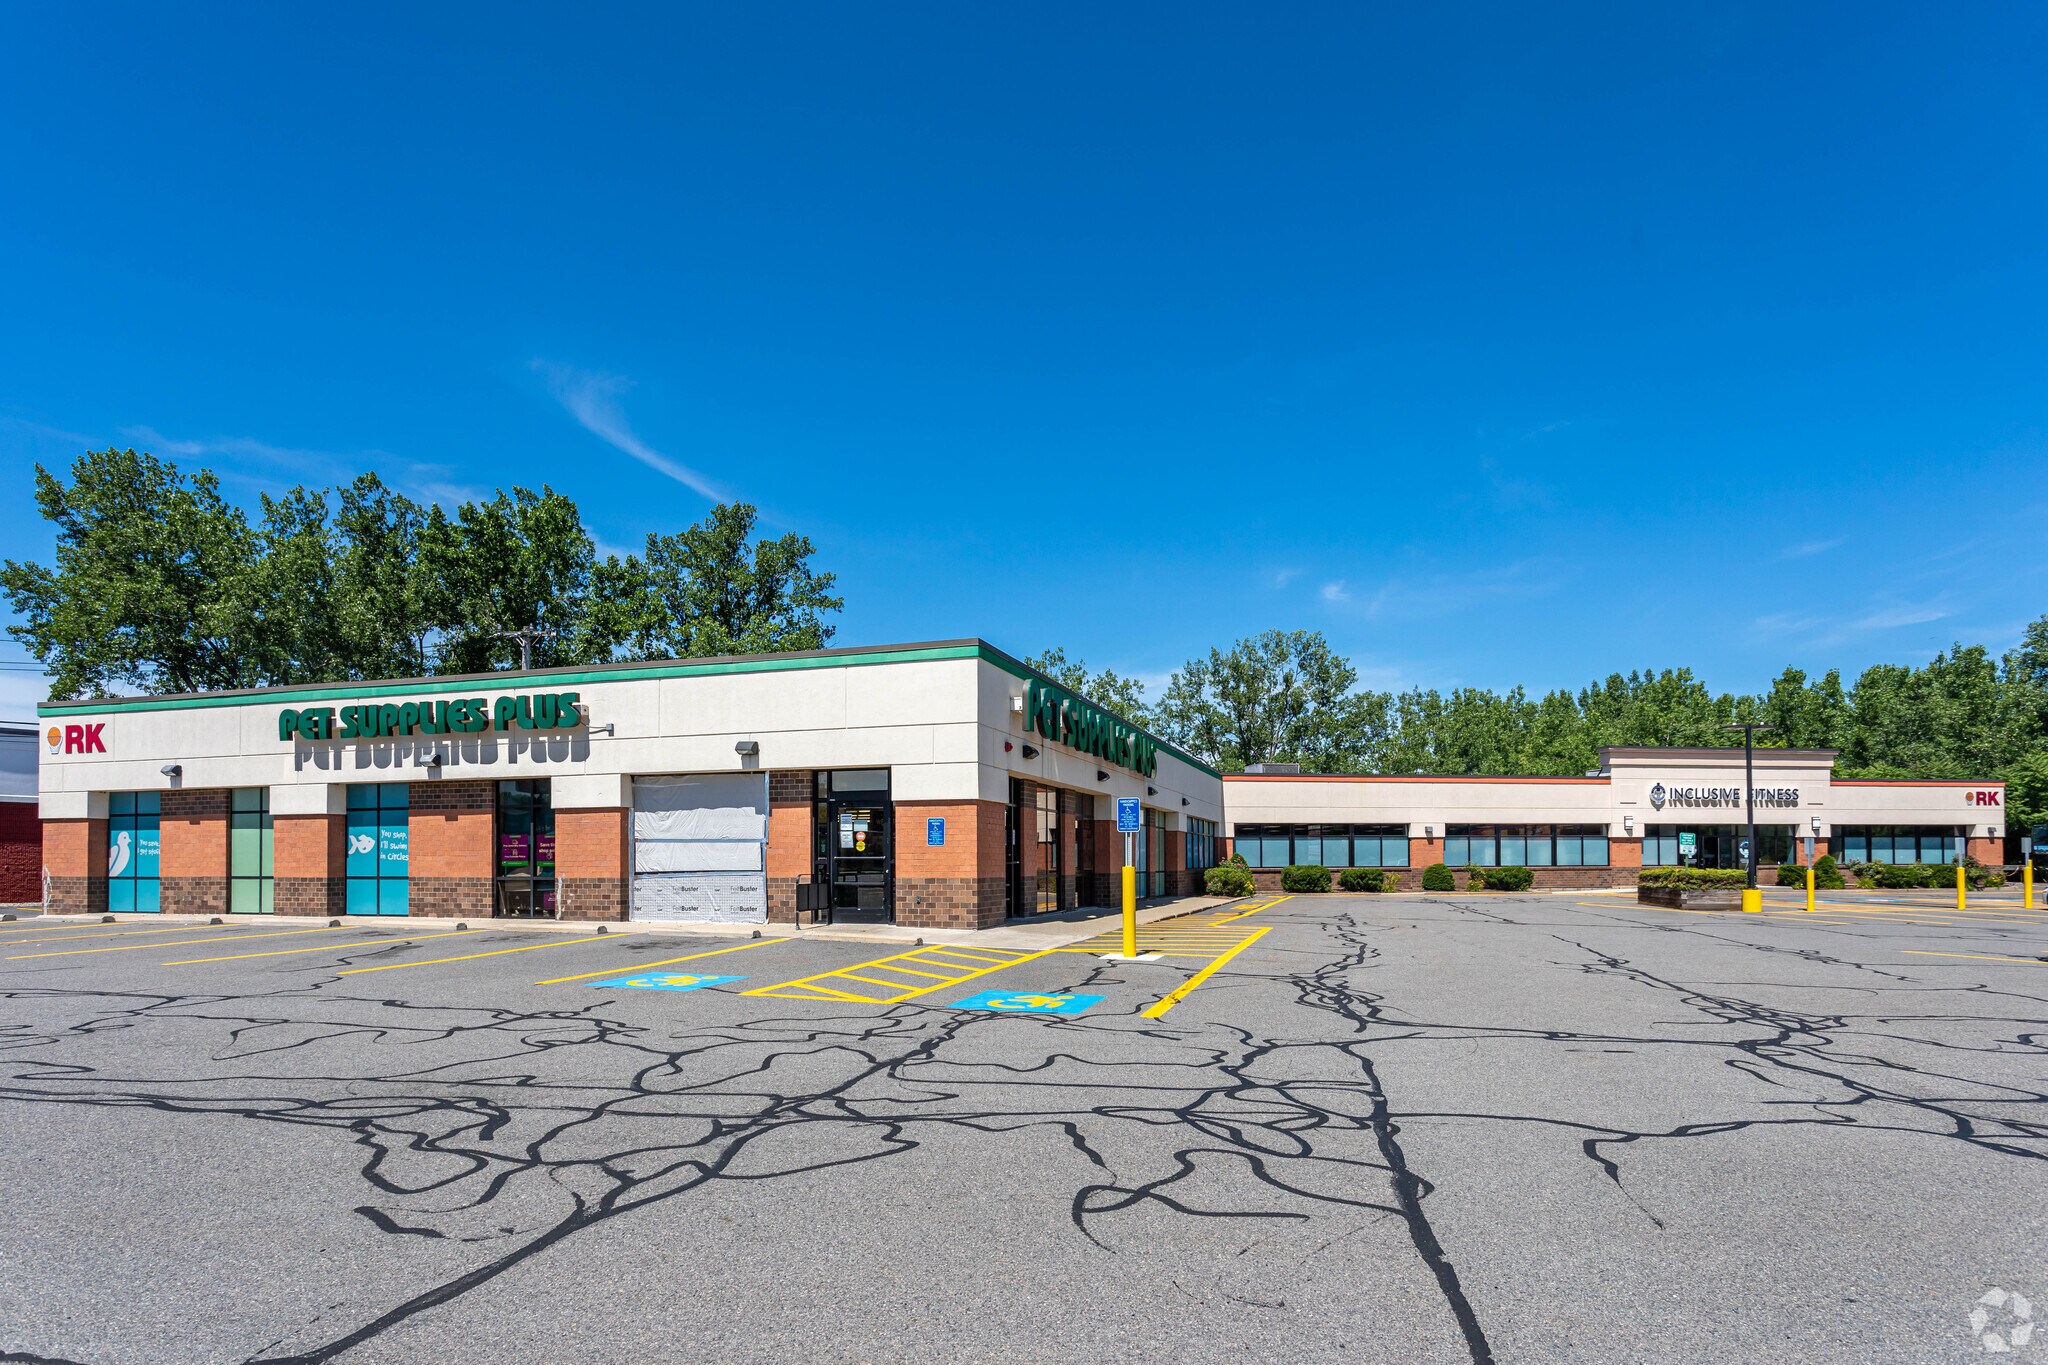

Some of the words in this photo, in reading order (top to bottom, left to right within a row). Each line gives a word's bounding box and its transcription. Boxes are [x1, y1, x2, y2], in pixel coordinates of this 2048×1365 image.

[279, 707, 335, 741] PET
[340, 698, 488, 738] SUPPLIES
[494, 692, 580, 731] PLUS
[65, 723, 107, 754] RK
[1022, 679, 1063, 742] PET
[1062, 699, 1131, 769] SUPPLIES
[1129, 732, 1157, 779] PLUS
[1669, 787, 1740, 800] INCLUSIVE
[1976, 791, 2000, 806] RK
[381, 829, 392, 838] You
